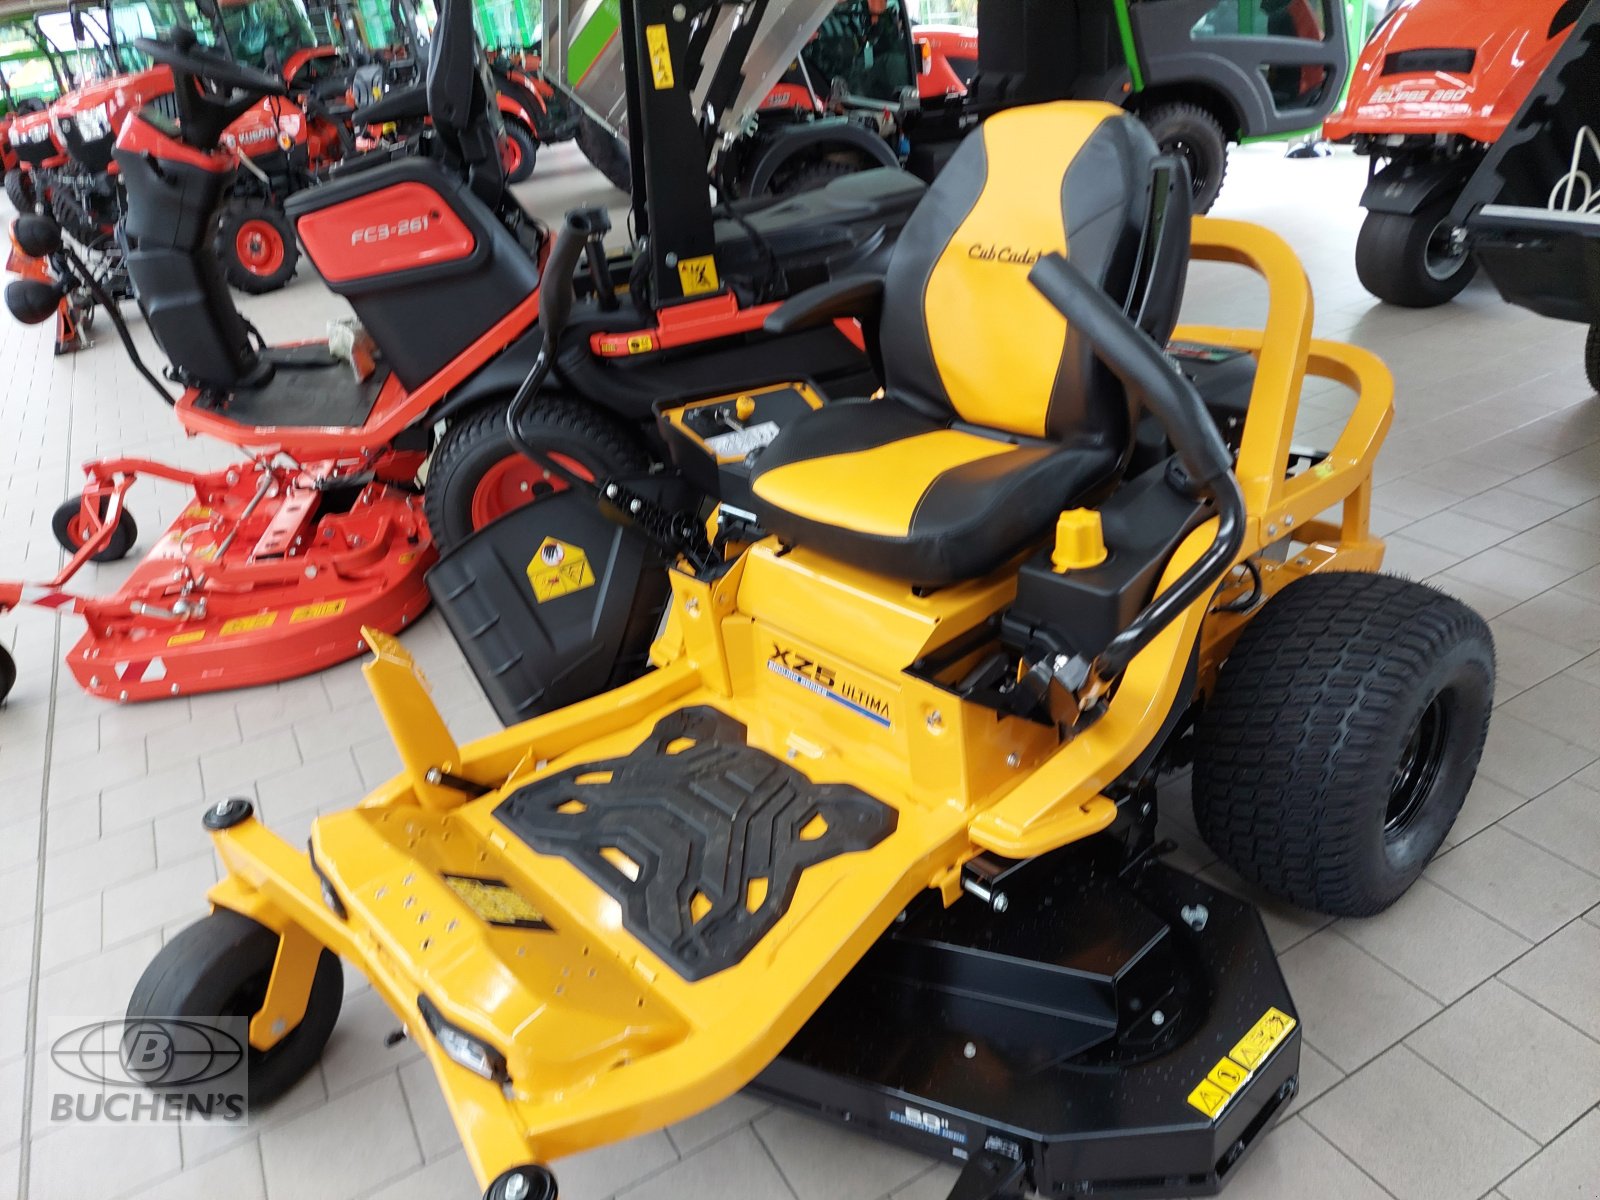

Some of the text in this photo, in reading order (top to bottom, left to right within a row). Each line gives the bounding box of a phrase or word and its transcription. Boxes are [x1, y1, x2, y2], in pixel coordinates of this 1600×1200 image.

[351, 214, 429, 247] FC3-261
[968, 242, 996, 262] Cub
[770, 642, 837, 689] XZ5
[841, 680, 891, 719] ULTIMA
